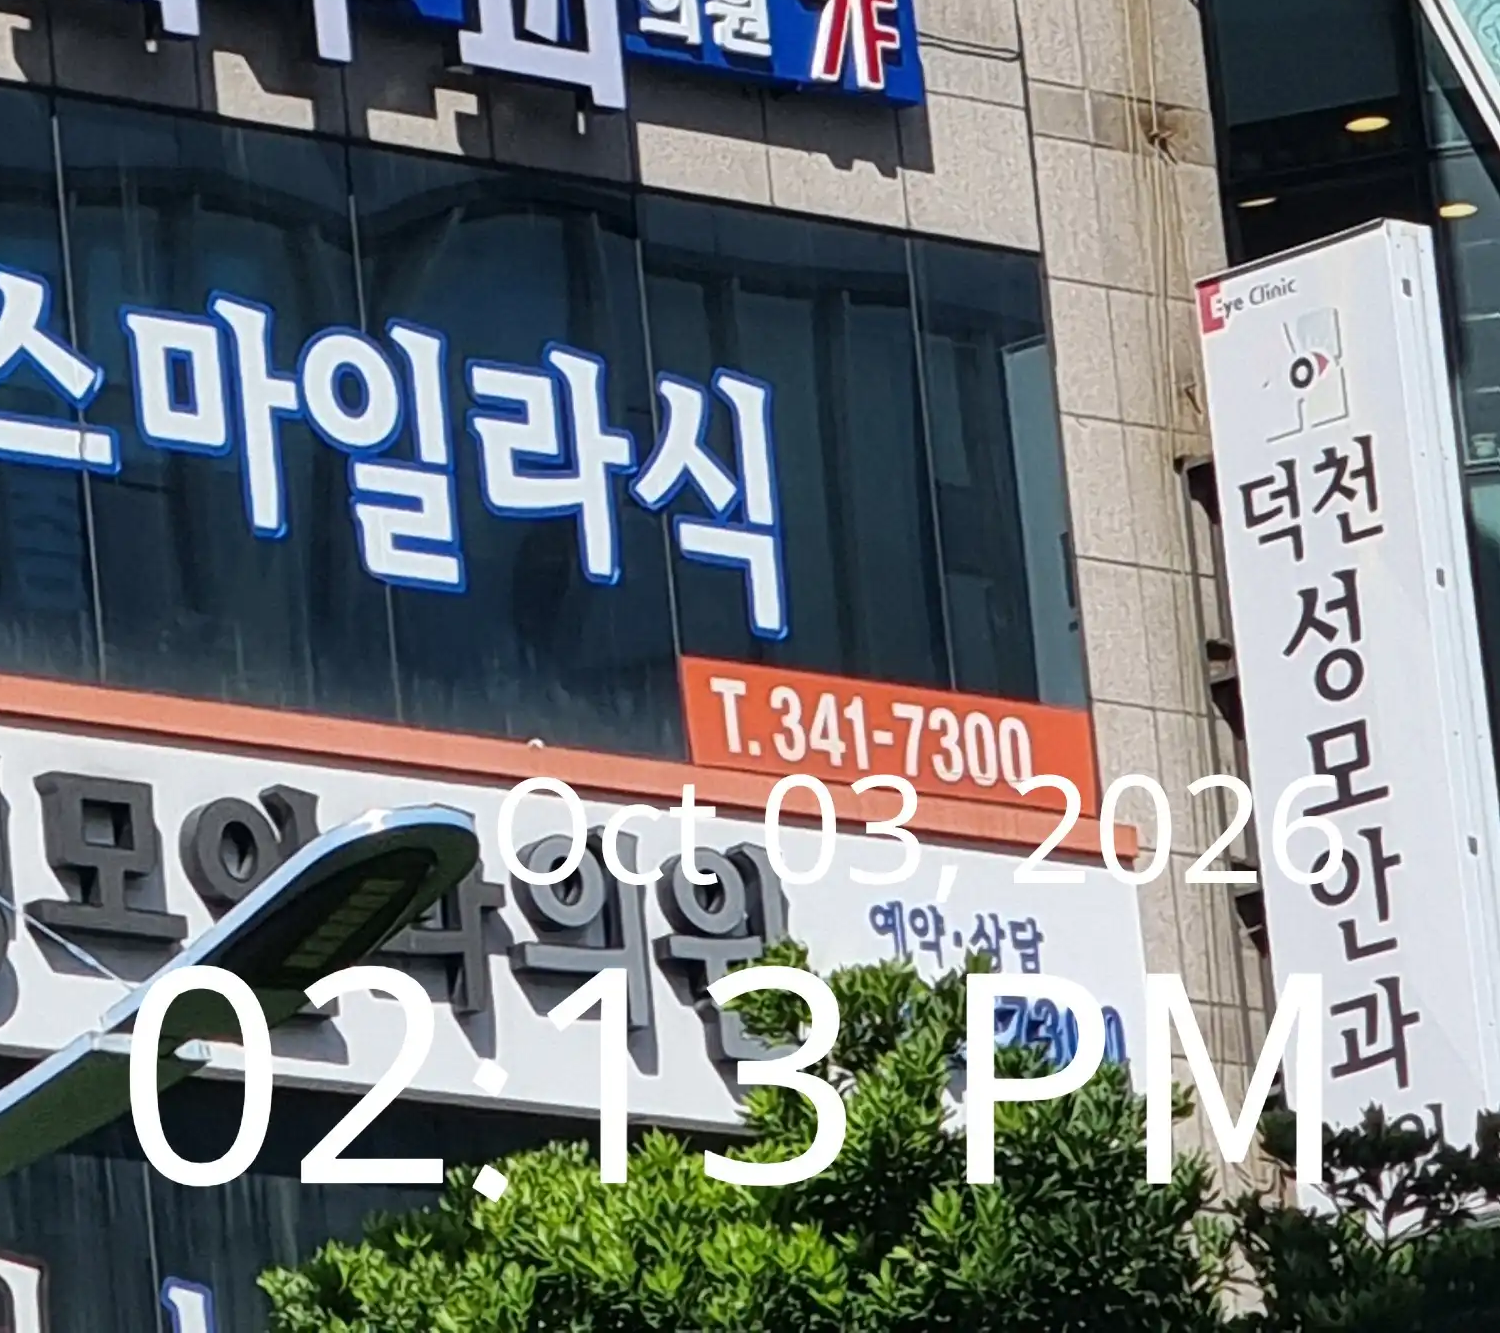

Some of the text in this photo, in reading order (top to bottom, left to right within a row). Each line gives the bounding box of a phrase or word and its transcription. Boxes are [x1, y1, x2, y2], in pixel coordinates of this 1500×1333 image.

[1250, 278, 1297, 305] Clinic
[1238, 435, 1385, 561] 덕천
[710, 678, 1034, 785] T. 341-7300
